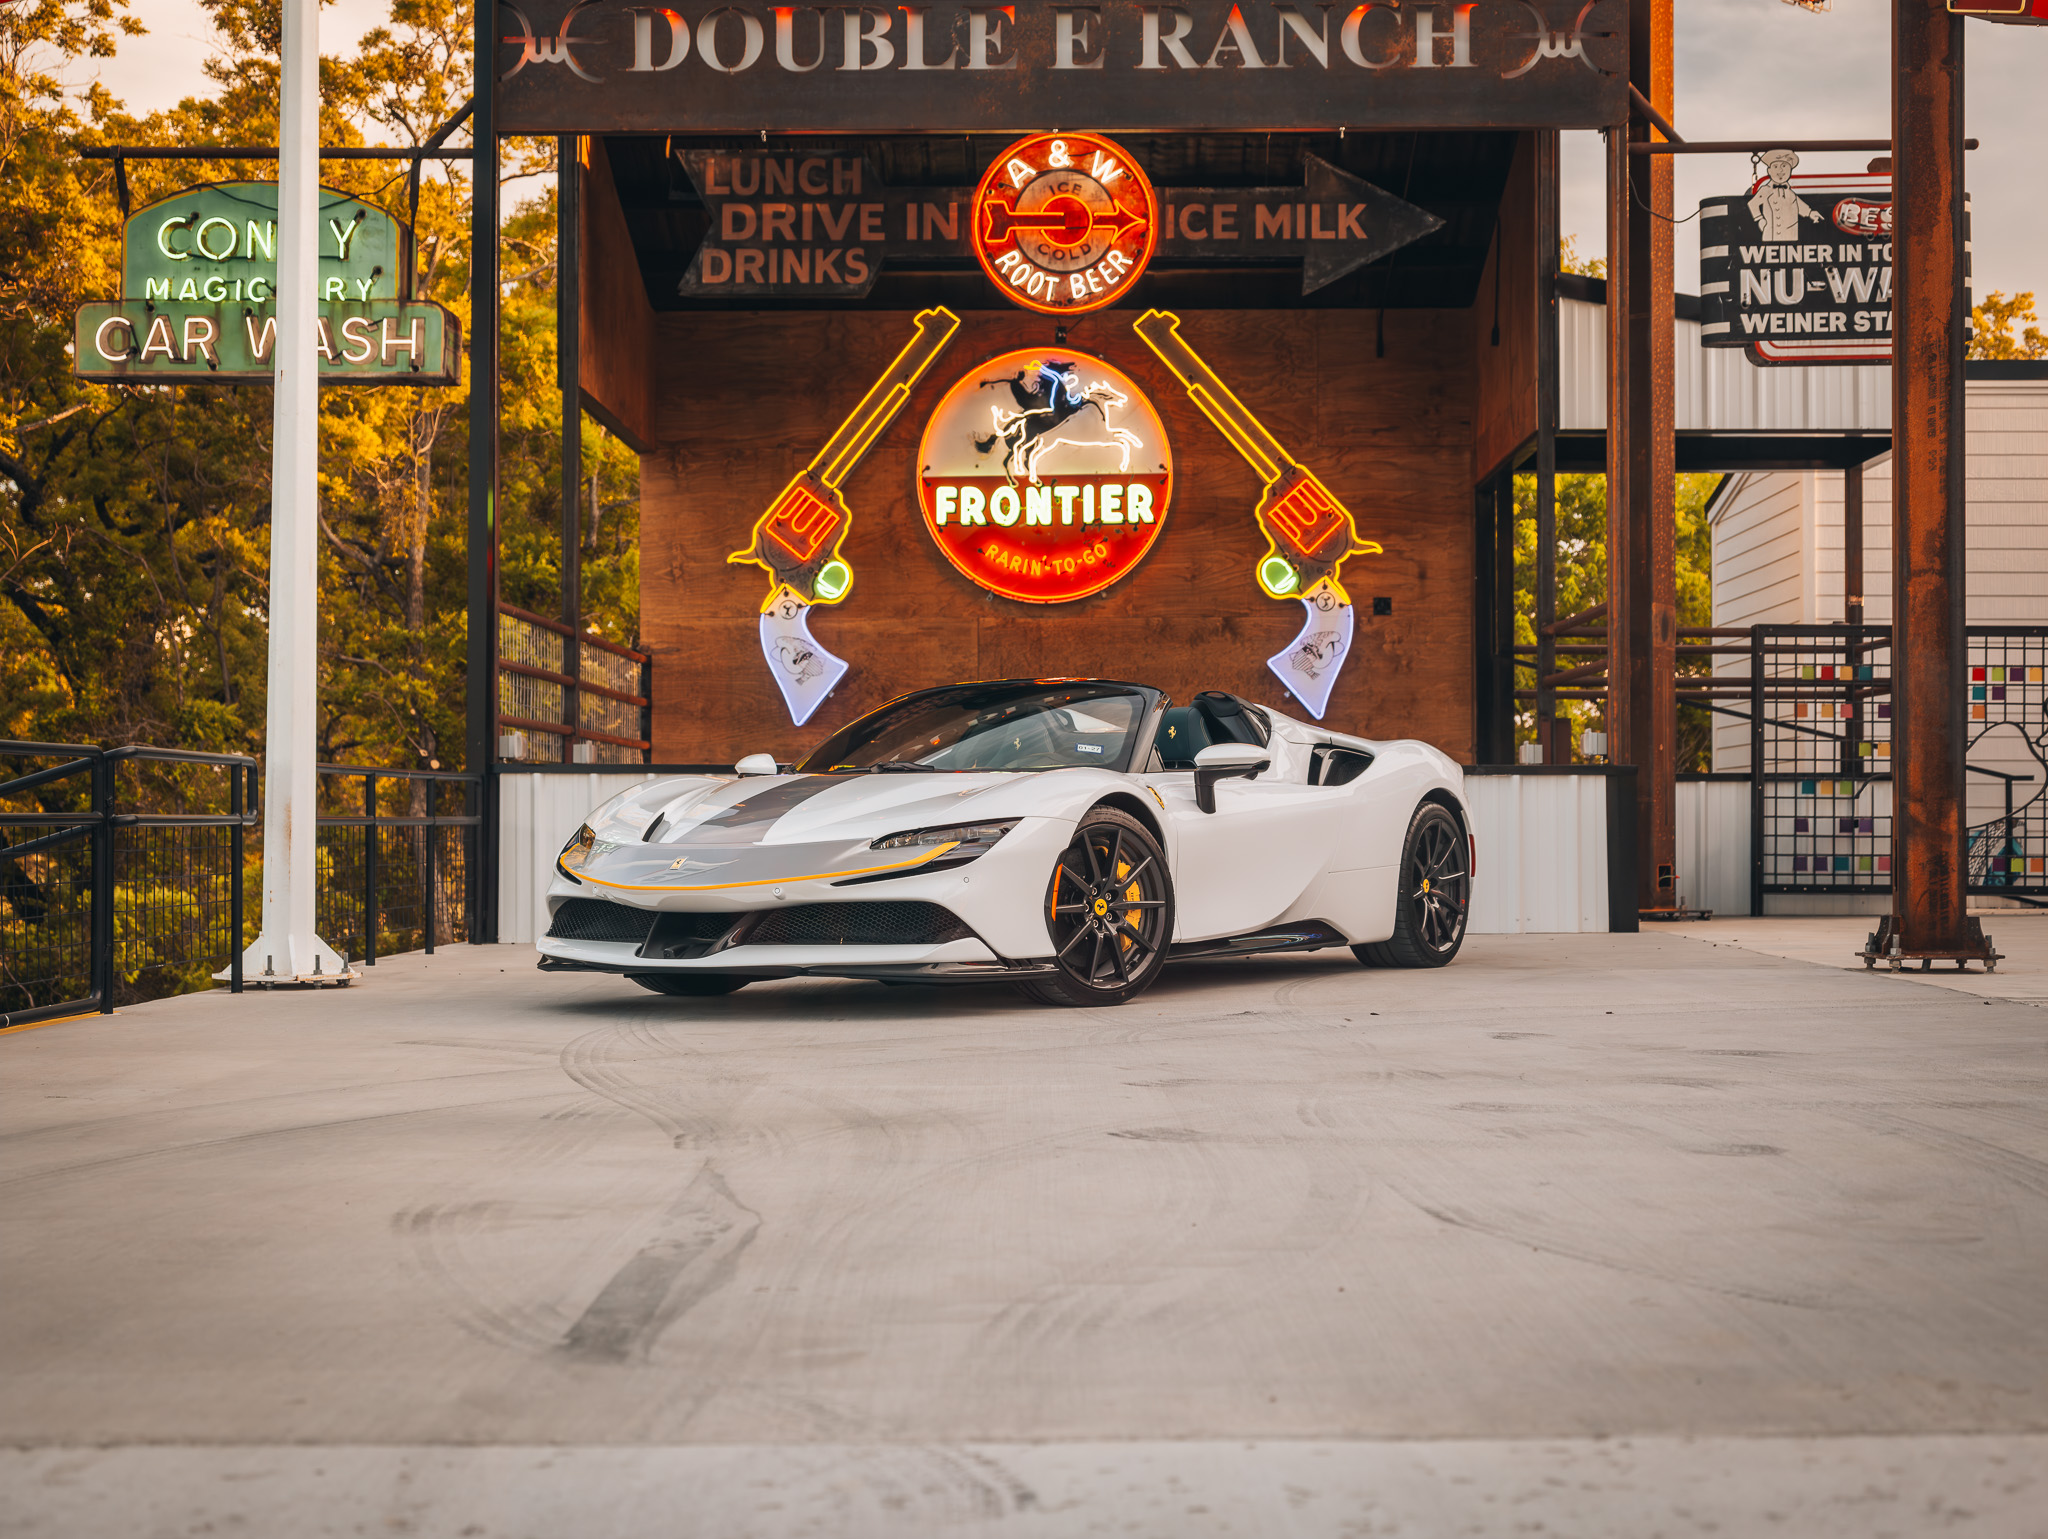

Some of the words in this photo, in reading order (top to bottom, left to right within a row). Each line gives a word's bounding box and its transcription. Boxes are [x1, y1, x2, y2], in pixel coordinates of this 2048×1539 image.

[623, 5, 1017, 74] DOUBLE
[1048, 5, 1106, 70] E
[1134, 2, 1480, 70] RANCH
[705, 157, 863, 196] LUNCH
[1006, 158, 1037, 189] A
[1048, 140, 1070, 167] &
[1091, 150, 1124, 184] W
[1049, 182, 1082, 196] ICE
[157, 216, 358, 262] CONY
[721, 203, 885, 241] DRIVE
[906, 202, 958, 240] IN
[1165, 204, 1238, 240] ICE
[1255, 203, 1368, 240] MILK
[702, 248, 869, 285] DRINKS
[1037, 243, 1092, 261] COLD
[1740, 244, 1833, 263] WEINER
[1839, 244, 1862, 262] IN
[145, 276, 267, 303] MAGIC
[324, 276, 374, 302] RY
[995, 250, 1060, 302] ROOT
[1070, 250, 1134, 299] BEER
[95, 314, 221, 365] CAR
[1741, 312, 1847, 334] WEINER
[1853, 311, 1893, 332] ST
[936, 484, 1156, 527] FRONTIER
